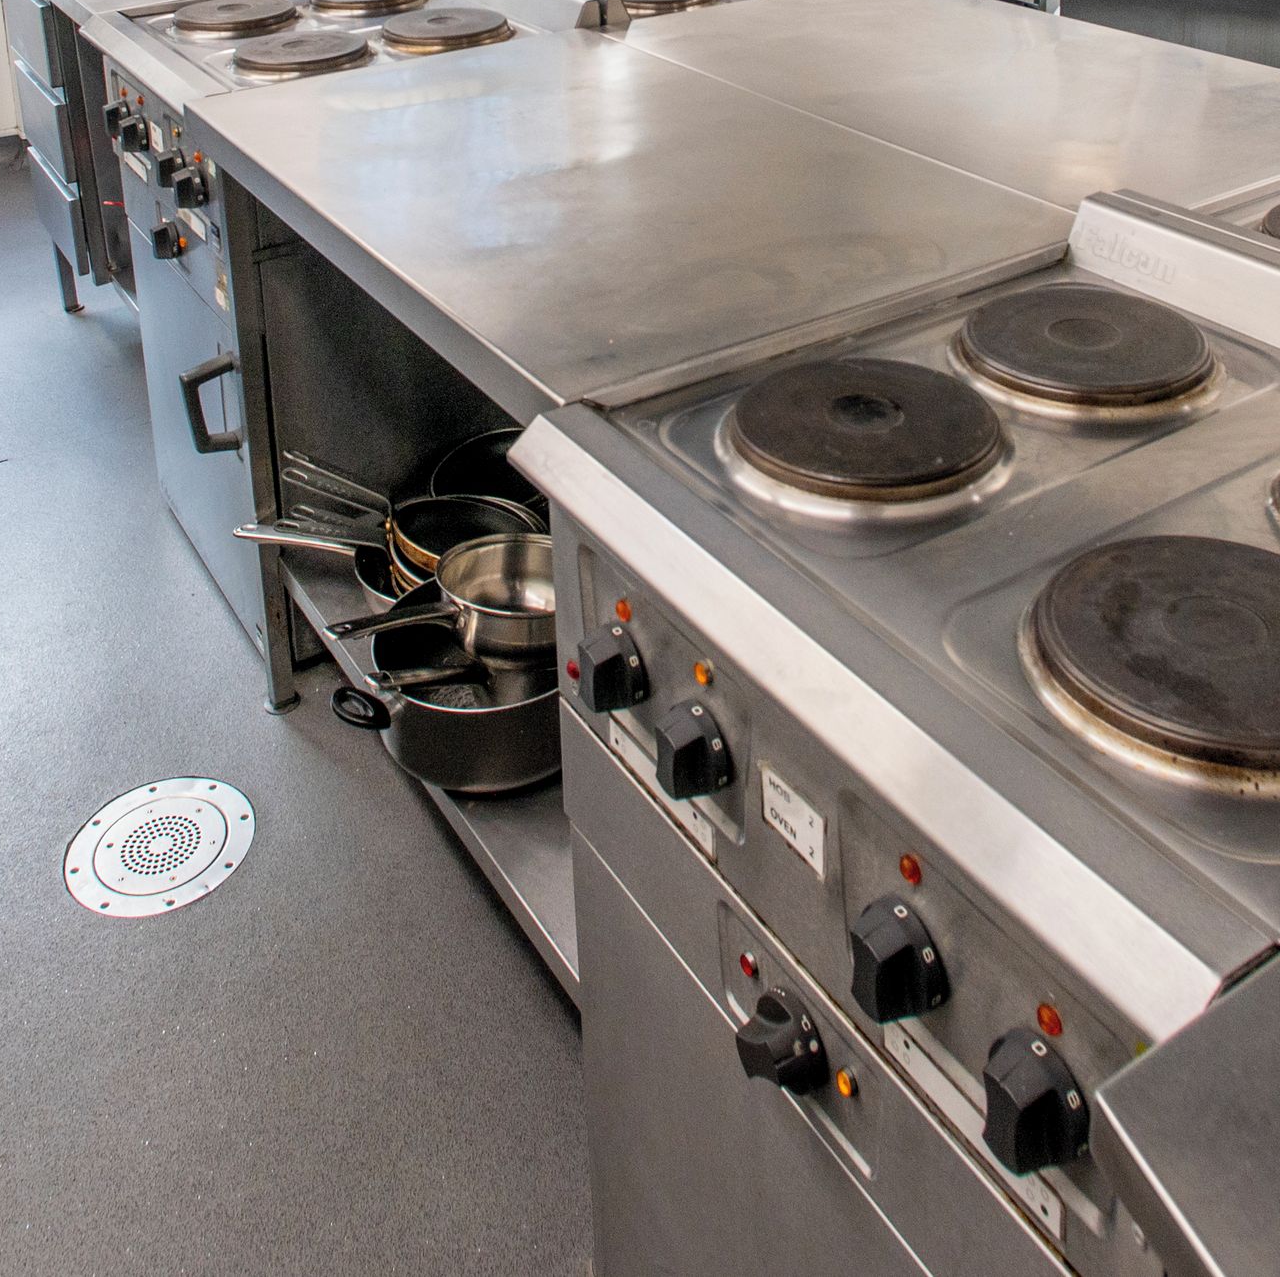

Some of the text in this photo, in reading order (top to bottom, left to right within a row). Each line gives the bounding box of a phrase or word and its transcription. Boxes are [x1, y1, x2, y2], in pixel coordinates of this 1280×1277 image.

[768, 776, 814, 829] HOB 2
[770, 807, 815, 859] OVEN 2
